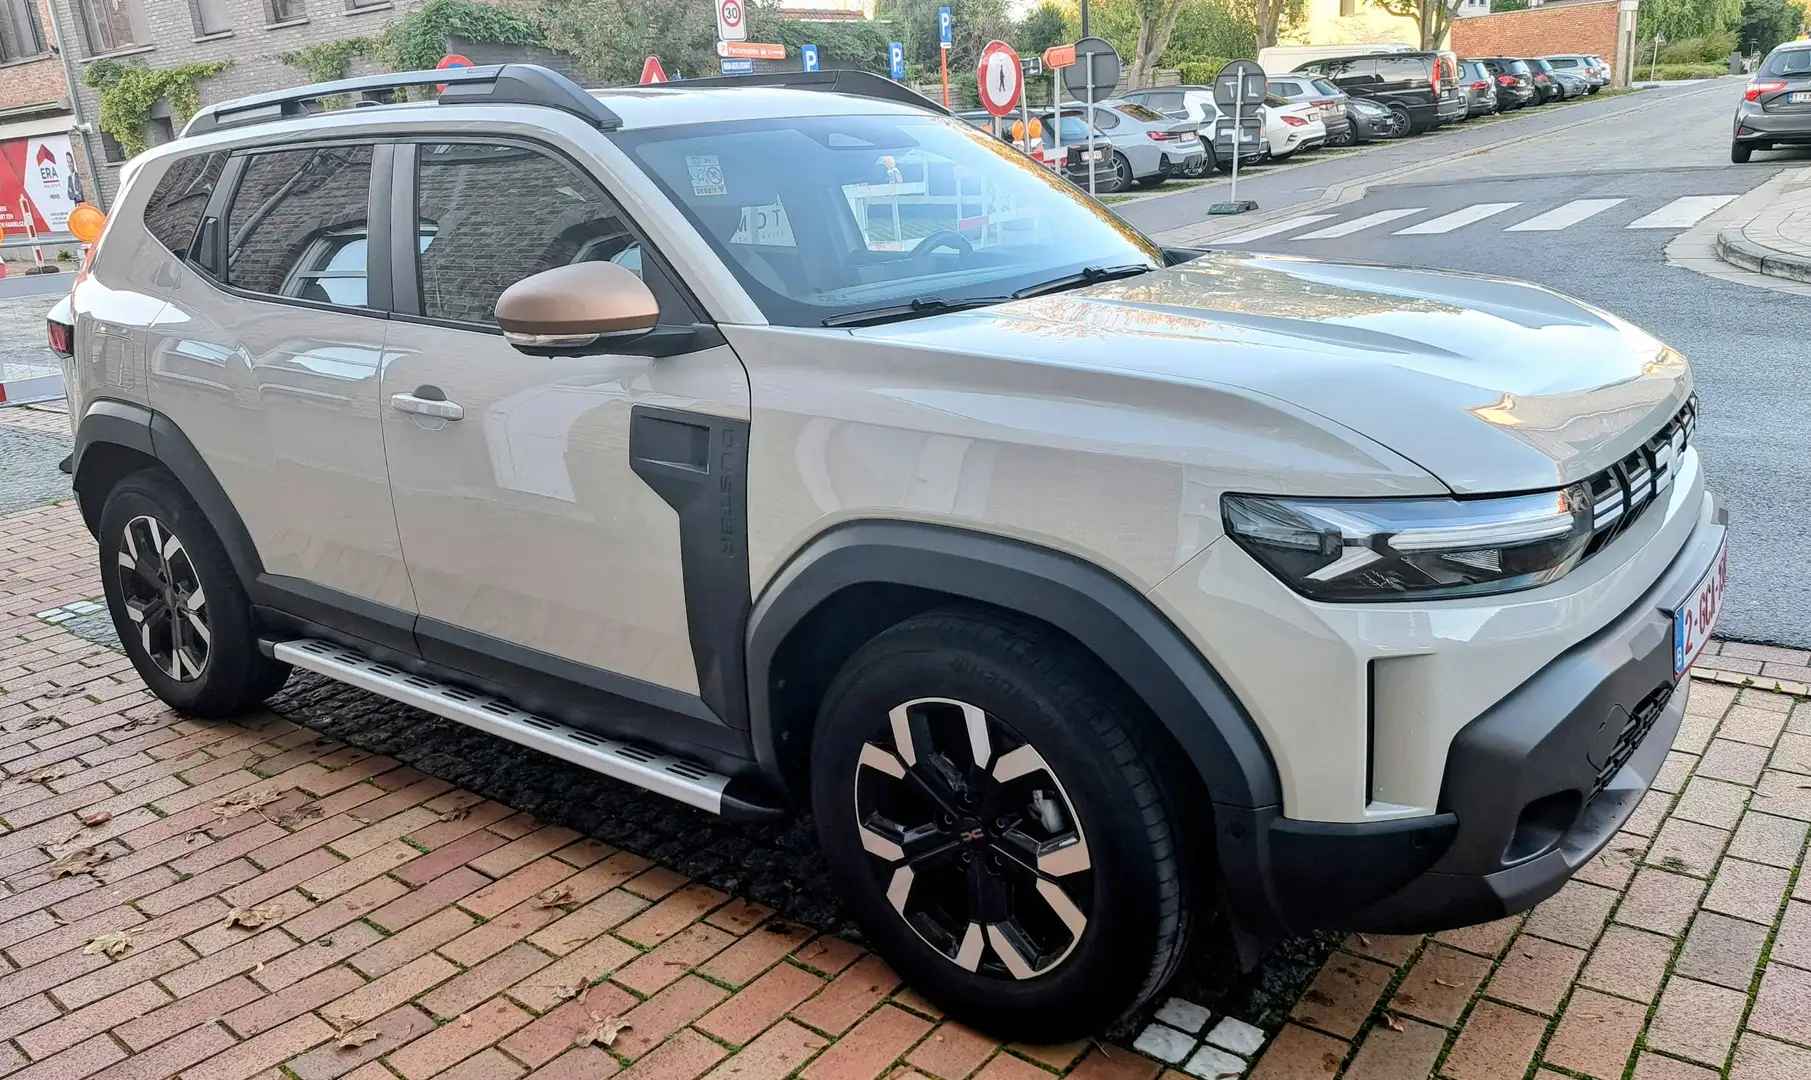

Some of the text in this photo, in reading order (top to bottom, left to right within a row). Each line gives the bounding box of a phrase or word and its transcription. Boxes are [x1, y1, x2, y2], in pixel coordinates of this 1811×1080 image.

[725, 7, 738, 19] 30
[941, 13, 950, 36] P
[805, 50, 817, 72] P
[893, 48, 901, 72] P
[40, 167, 59, 179] ERA
[720, 428, 736, 559] DUSTER
[1677, 646, 1683, 667] B
